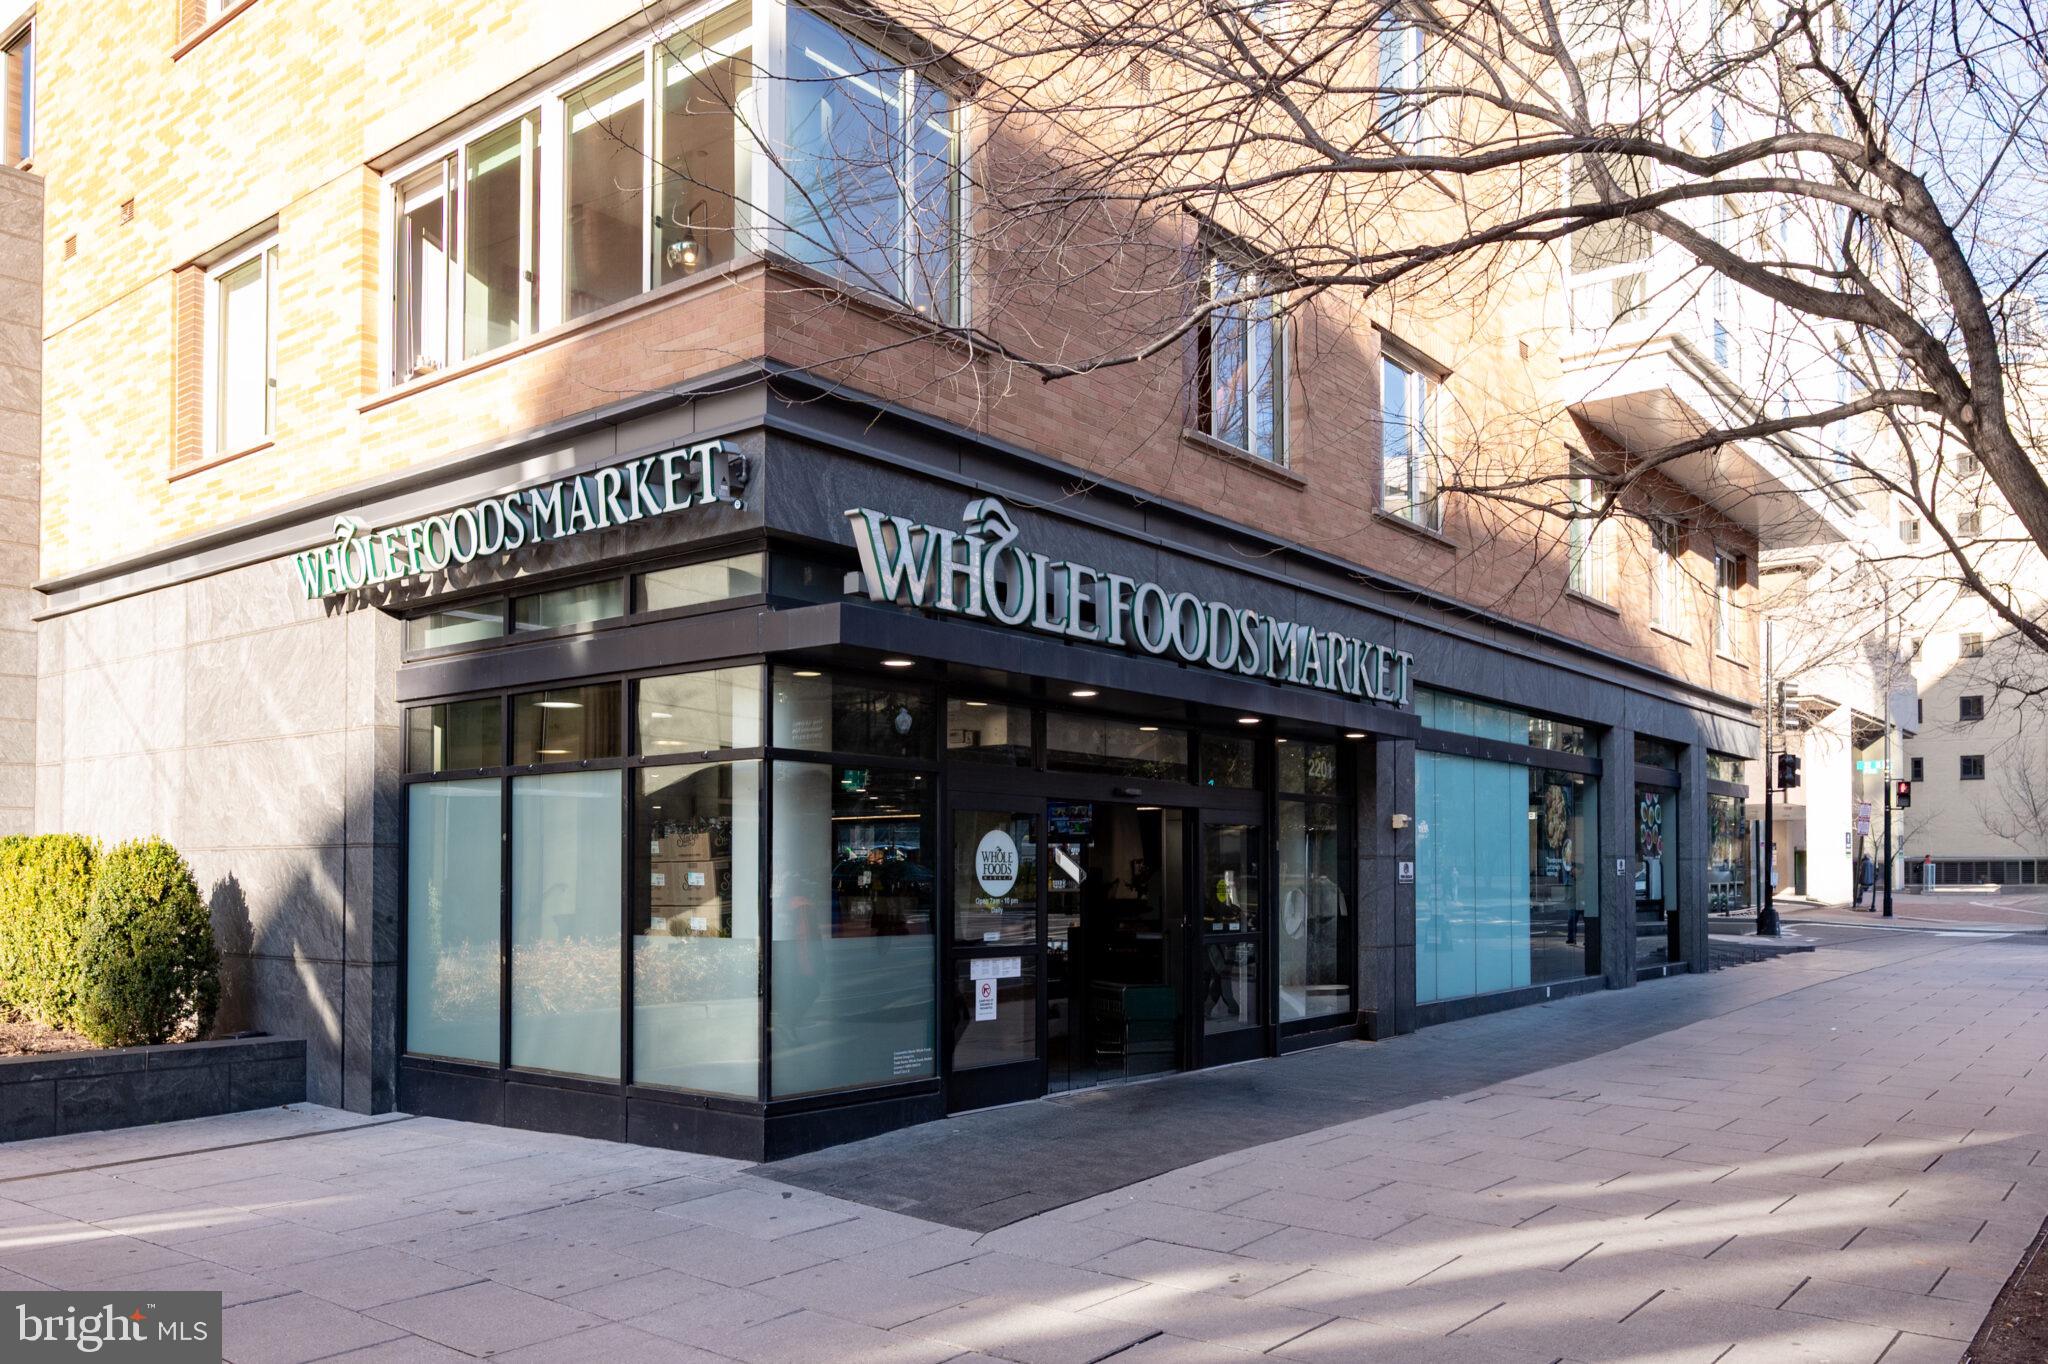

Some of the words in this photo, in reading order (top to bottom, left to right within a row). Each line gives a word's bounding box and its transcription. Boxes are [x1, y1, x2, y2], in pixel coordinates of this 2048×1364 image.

[293, 516, 403, 600] WHOLE
[404, 493, 526, 576] FOODS
[528, 440, 724, 543] MARKET
[843, 498, 1101, 639] WHOLE
[1100, 573, 1261, 676] FOODS
[1263, 615, 1415, 706] MARKET
[981, 846, 1013, 863] WHOLE
[982, 863, 1012, 875] FOODS
